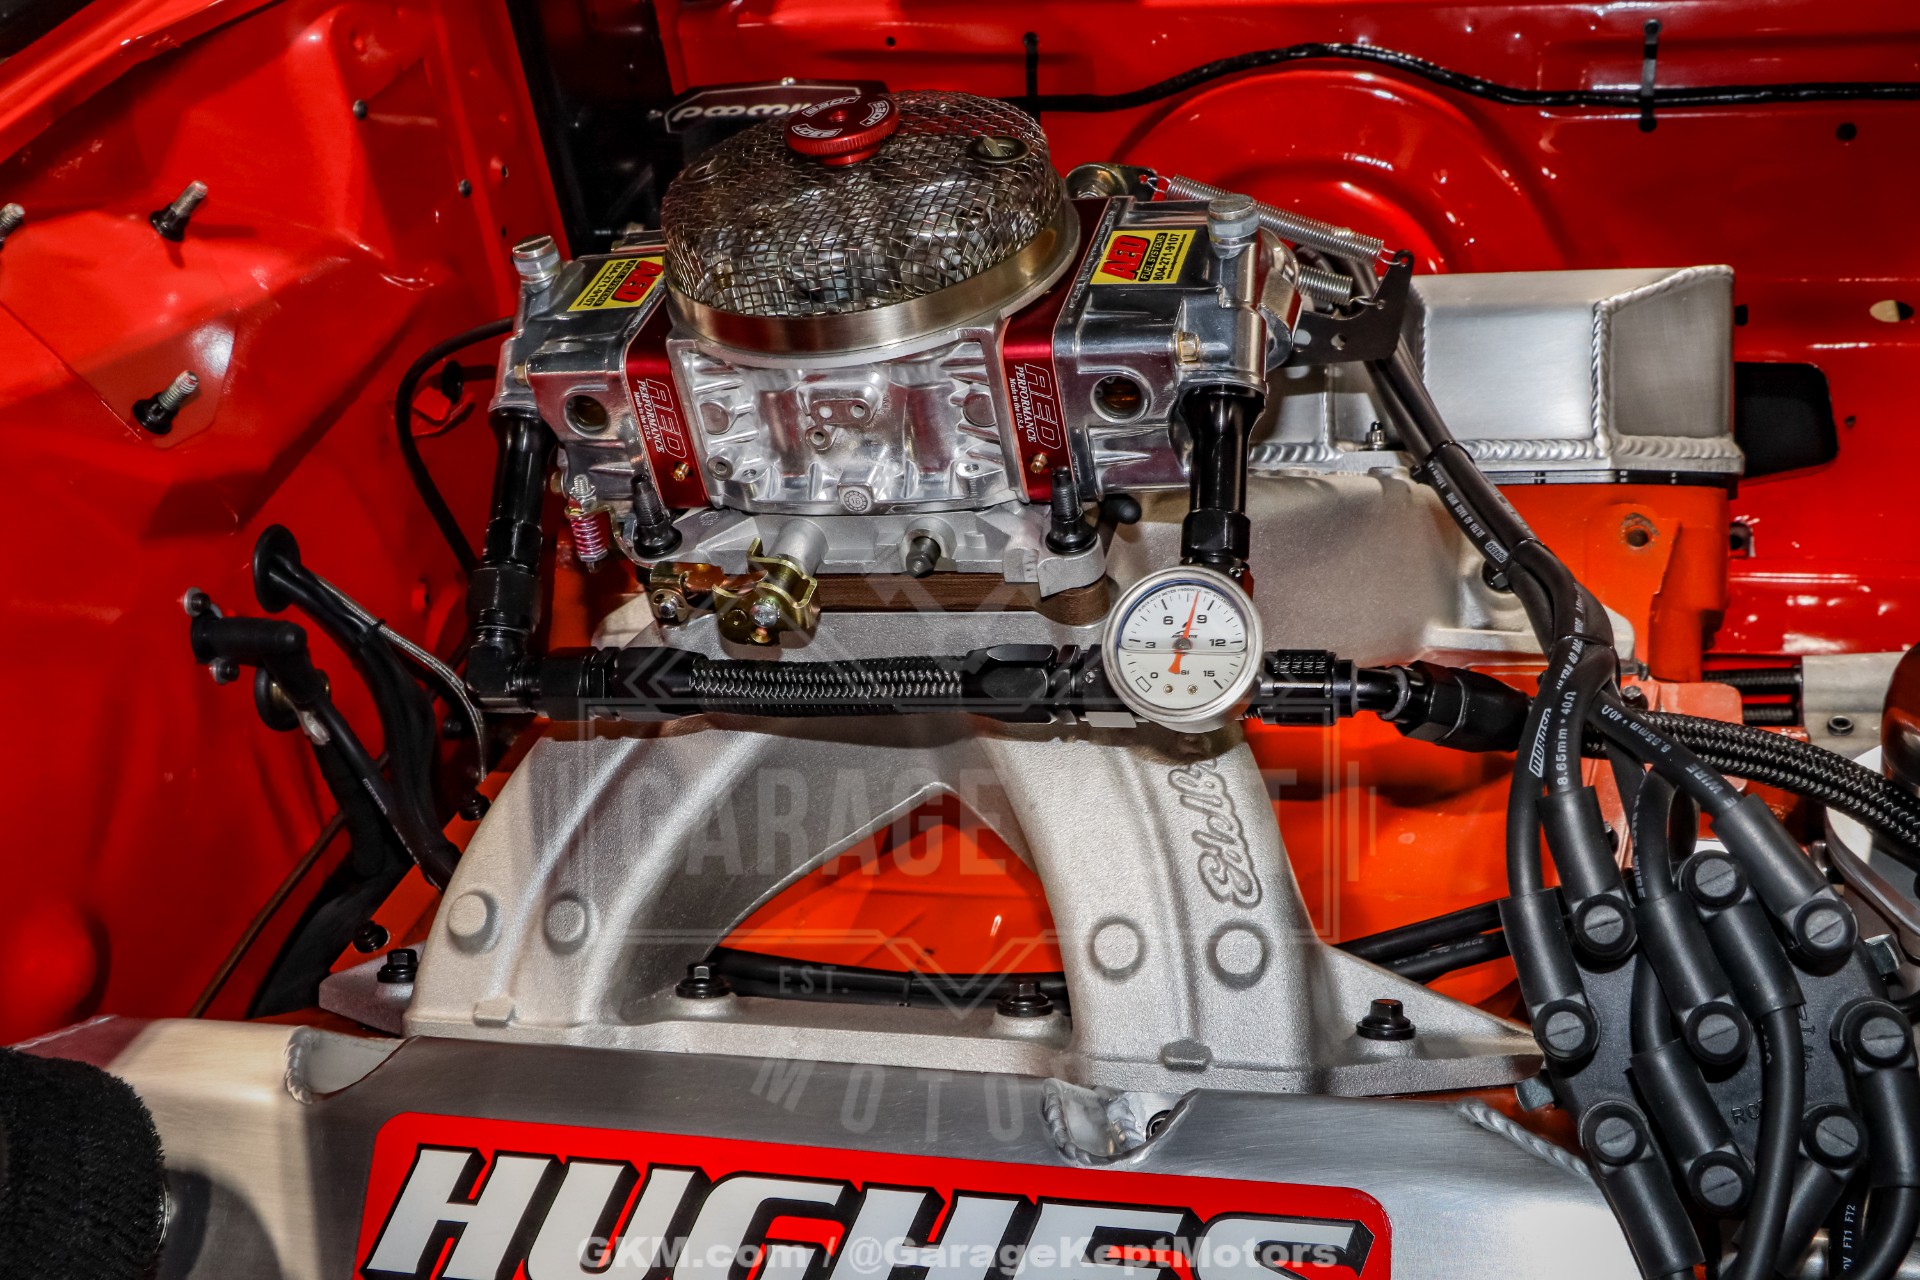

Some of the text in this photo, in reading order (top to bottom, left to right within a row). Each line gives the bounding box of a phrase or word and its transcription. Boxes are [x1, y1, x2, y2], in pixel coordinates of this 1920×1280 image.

[866, 101, 888, 126] JOES
[1100, 235, 1150, 281] AED
[1141, 235, 1166, 280] FUEL SYSTEMS
[1153, 233, 1180, 281] 804-271-9107
[611, 260, 664, 303] AED
[634, 392, 642, 407] Made
[1009, 377, 1018, 394] Made
[637, 380, 665, 453] PERFORMANCE
[1015, 365, 1037, 442] PERFORMANCE
[1024, 363, 1061, 450] AED
[646, 378, 687, 458] AED
[1163, 615, 1174, 625] 6
[1196, 614, 1208, 624] 9
[1145, 641, 1156, 649] 3
[1208, 638, 1226, 647] 12
[1568, 651, 1579, 665] 40
[1150, 671, 1159, 679] 0
[1630, 721, 1672, 753] 8.65mm
[1555, 728, 1568, 786] 8.65mm
[1685, 763, 1724, 795] WIRE
[1844, 1204, 1856, 1223] FT2
[1843, 1230, 1853, 1249] FT1
